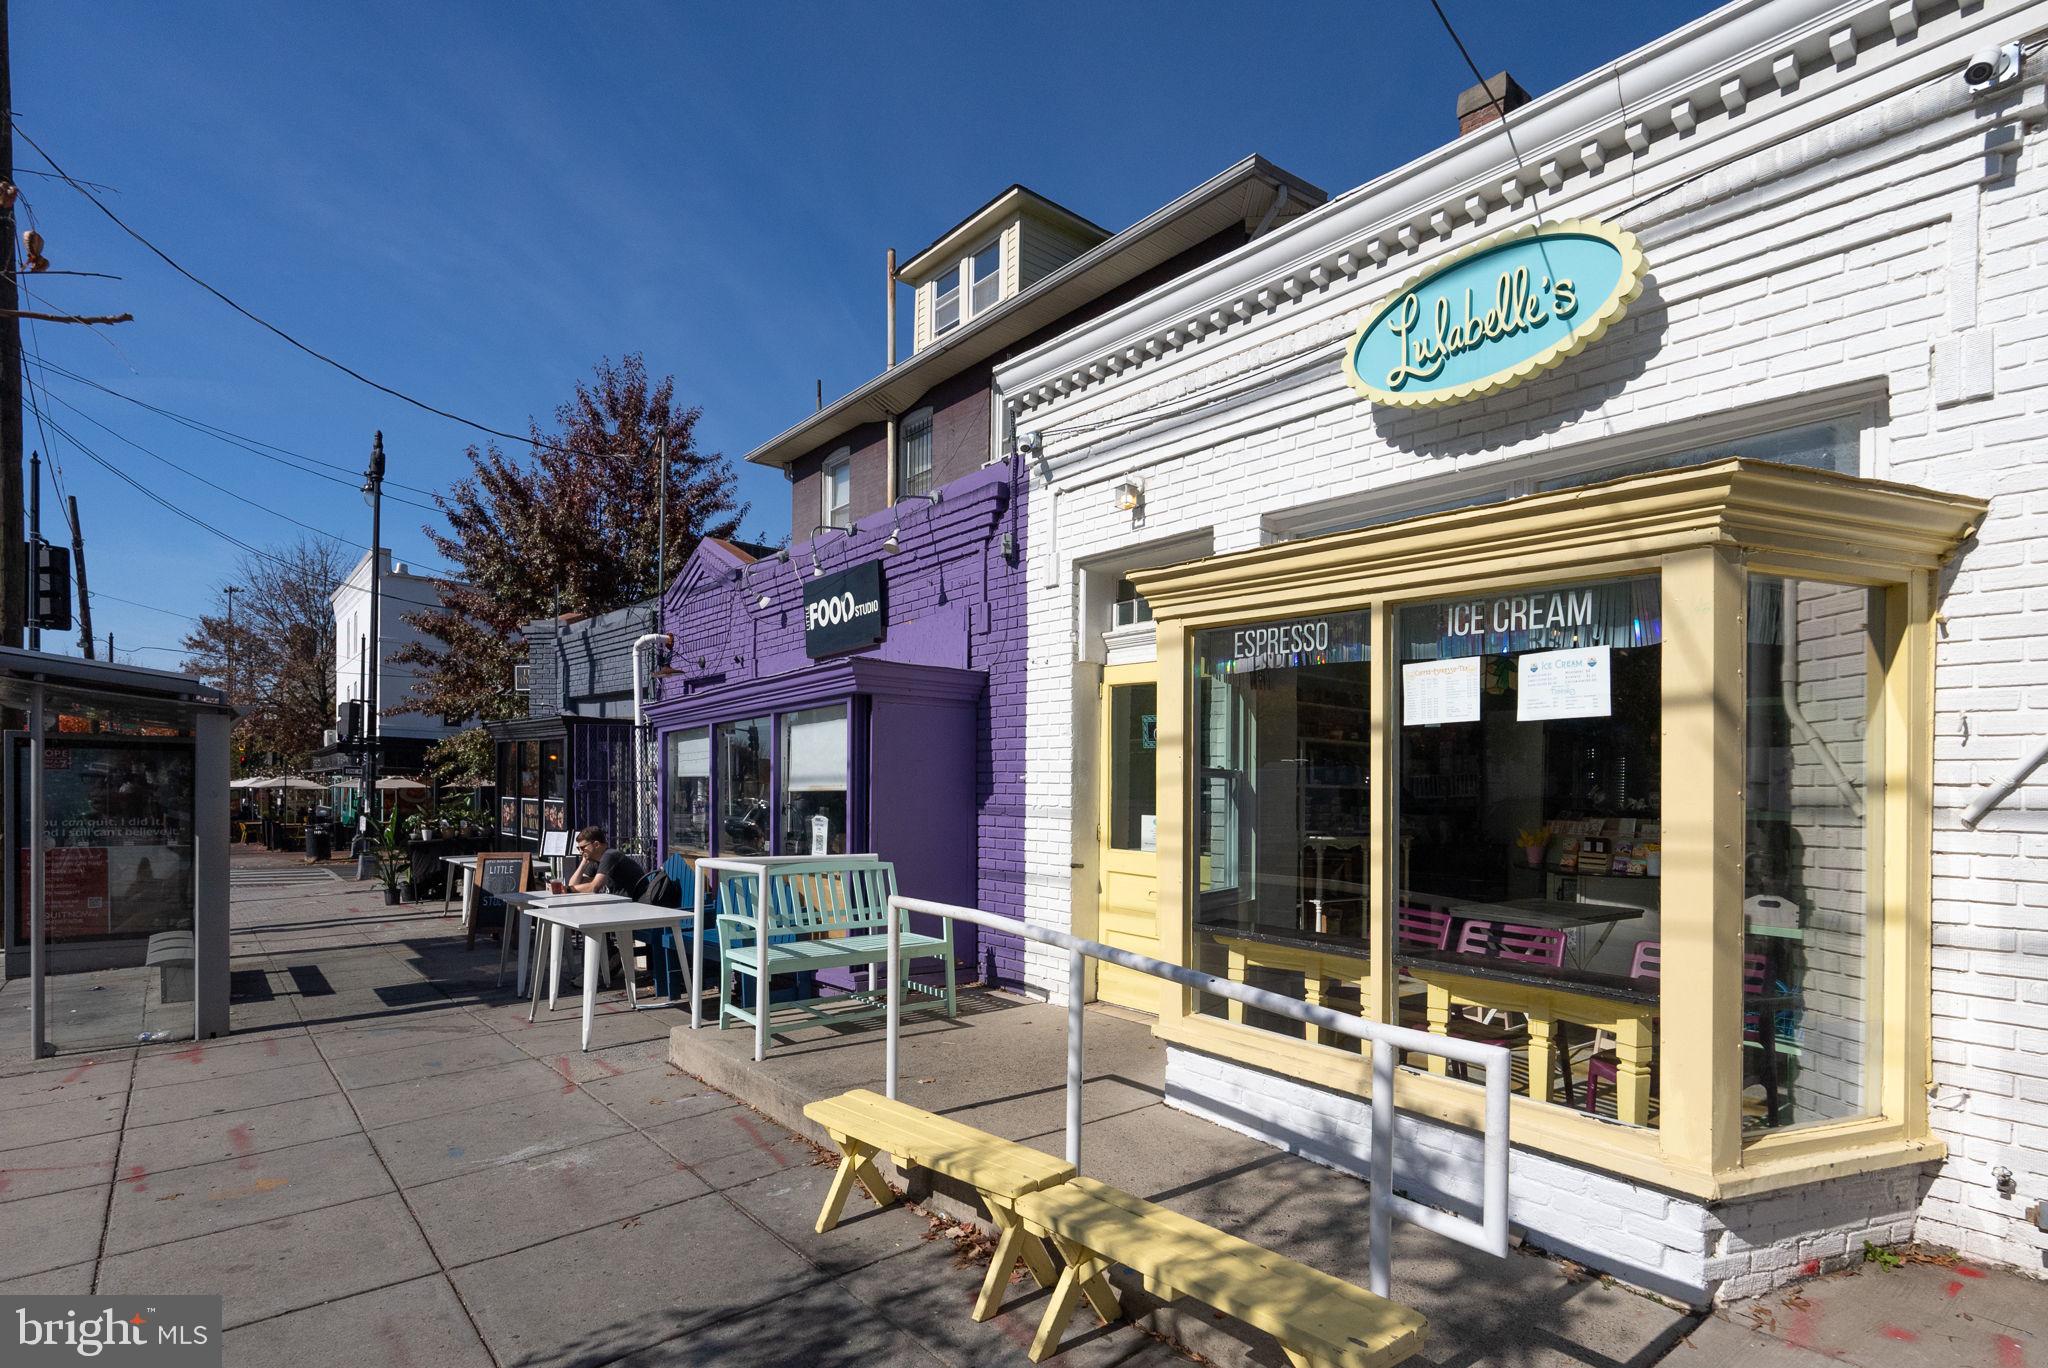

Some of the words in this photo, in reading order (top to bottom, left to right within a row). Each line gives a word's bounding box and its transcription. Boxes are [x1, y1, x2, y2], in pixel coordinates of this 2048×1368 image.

[1387, 265, 1576, 387] Lulabelle's
[810, 592, 855, 630] FOOD
[855, 600, 879, 618] STUDIO
[1446, 601, 1486, 637] ICE
[1493, 591, 1593, 633] CREAM
[1234, 622, 1329, 658] ESPRESSO
[489, 865, 514, 874] LITTLE
